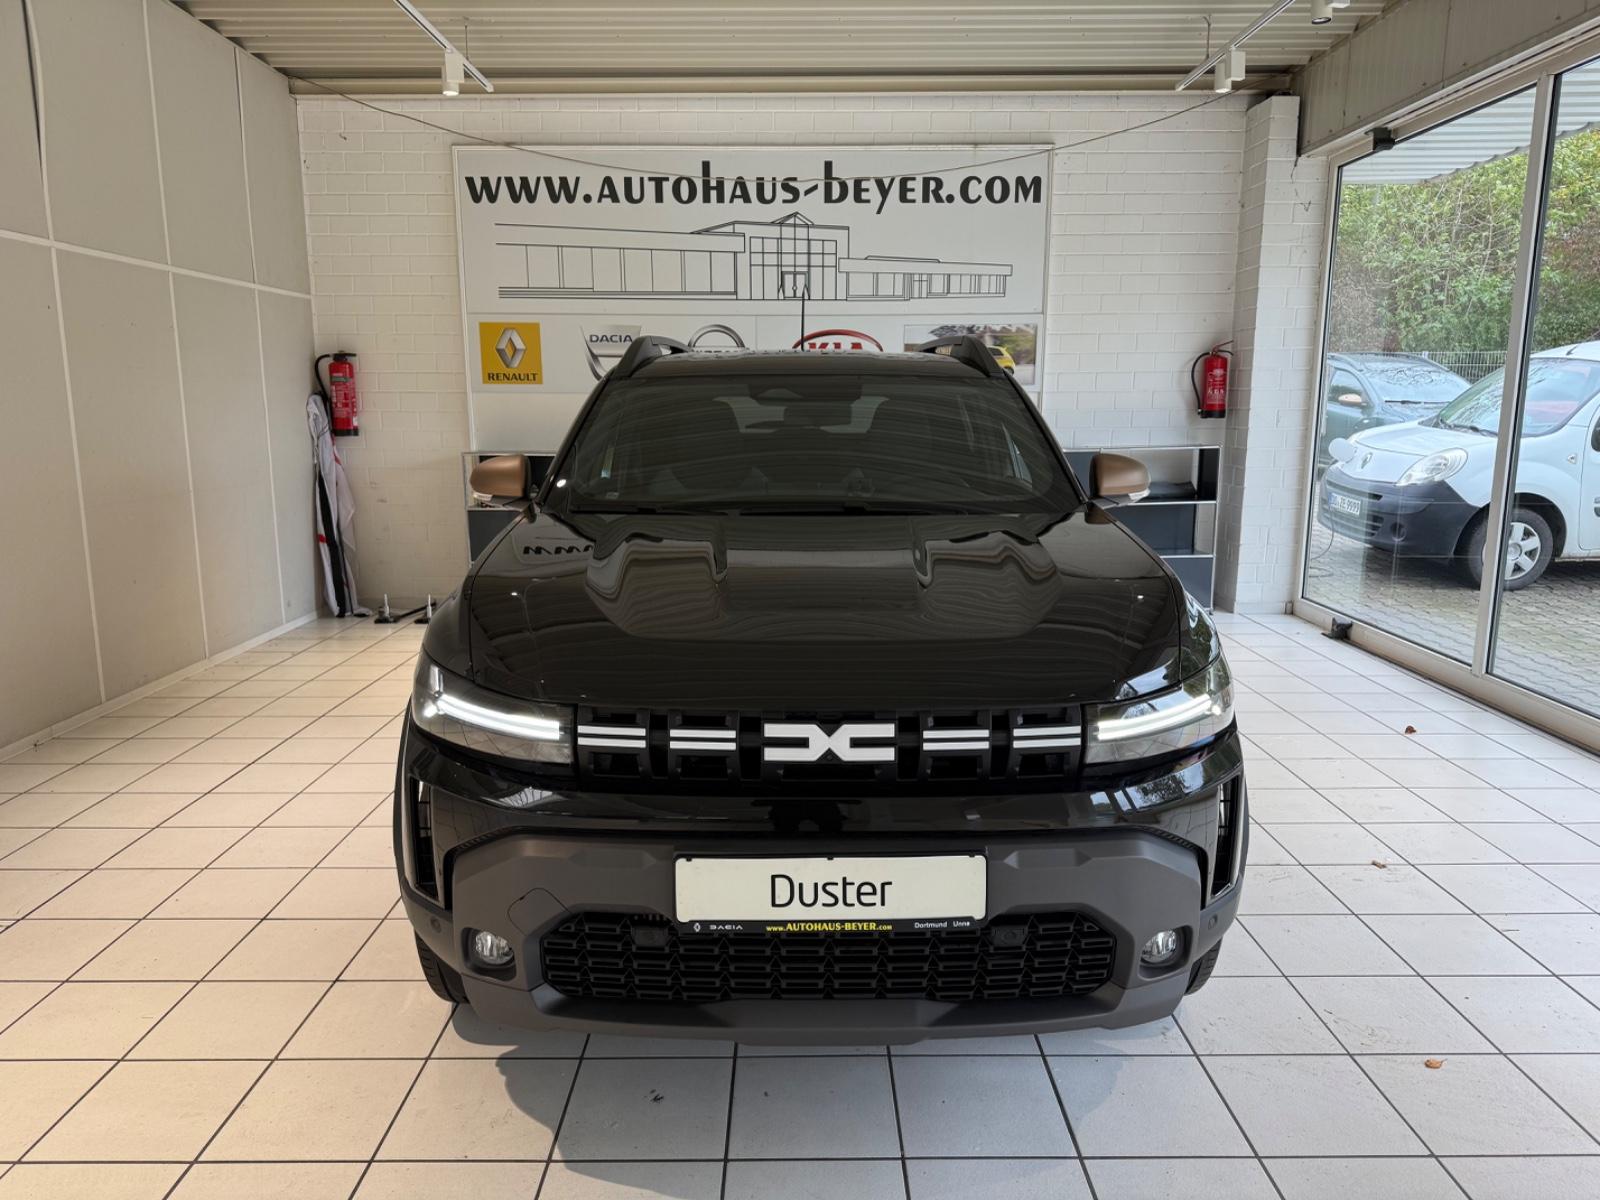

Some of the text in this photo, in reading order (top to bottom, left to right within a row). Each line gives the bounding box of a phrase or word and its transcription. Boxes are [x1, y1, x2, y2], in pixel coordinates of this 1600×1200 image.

[589, 334, 633, 343] DACIA
[487, 372, 539, 382] RENAULT
[770, 873, 892, 908] Duster
[766, 922, 892, 932] www.AUTOHAUS-BEYER.com
[914, 920, 947, 929] Dortmund
